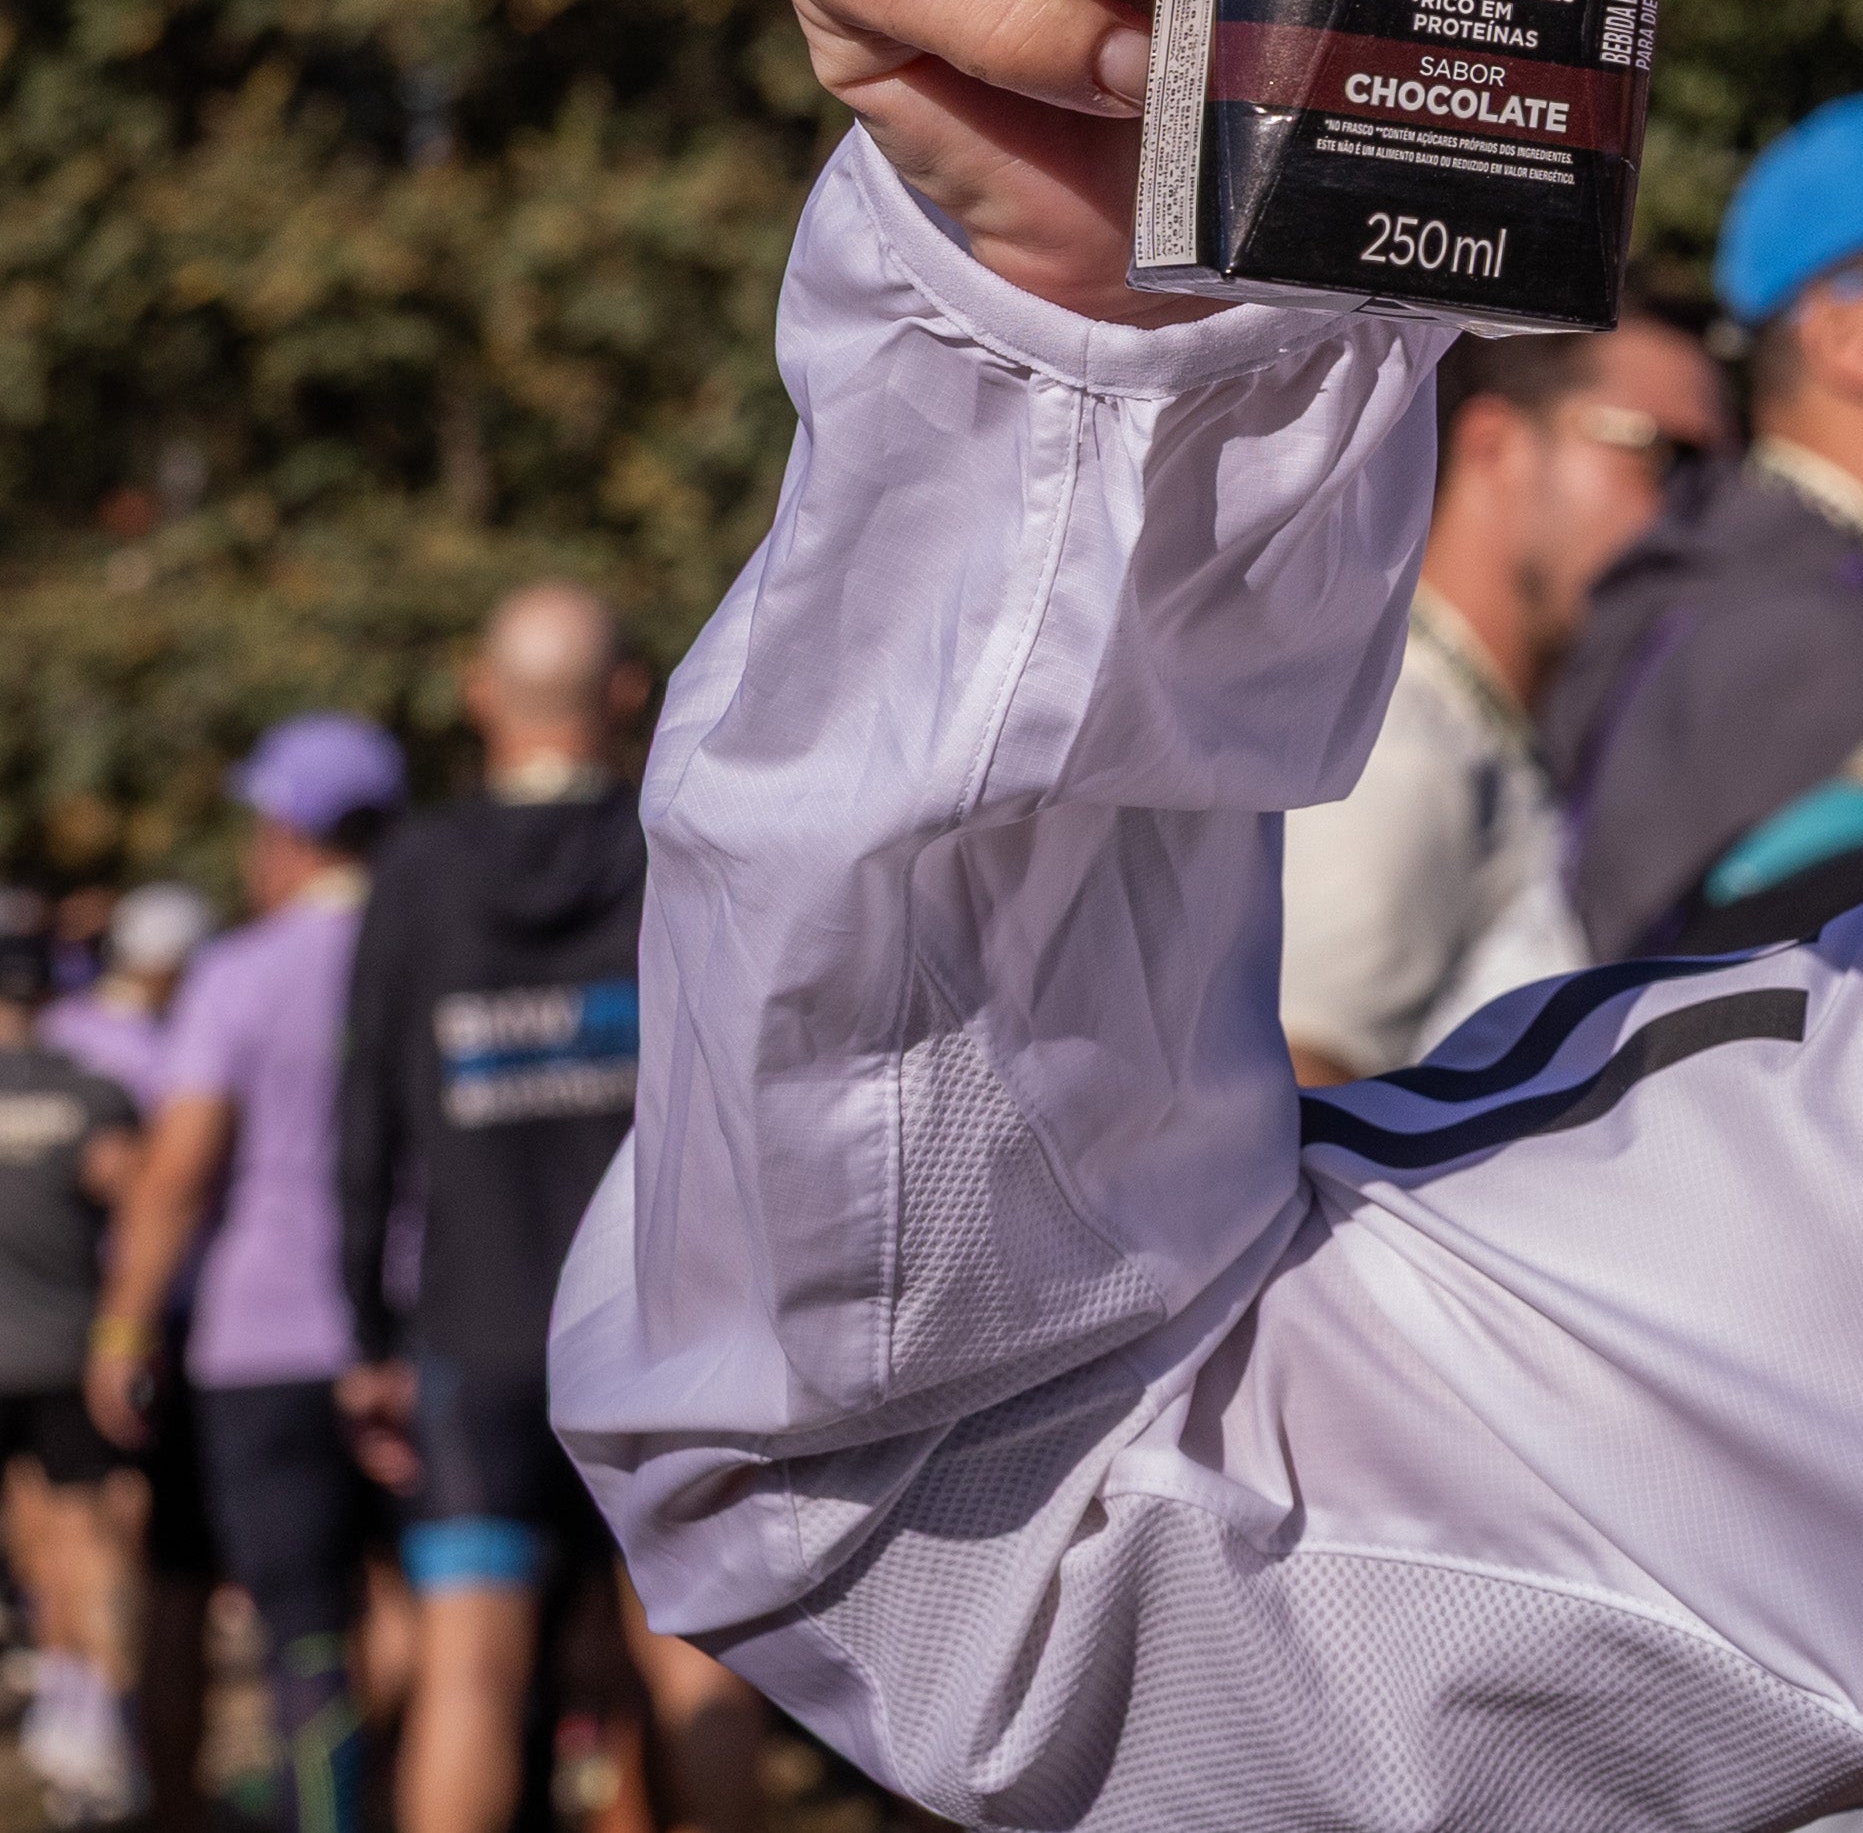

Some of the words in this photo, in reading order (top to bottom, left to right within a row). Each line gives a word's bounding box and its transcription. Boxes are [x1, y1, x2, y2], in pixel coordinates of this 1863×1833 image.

[1480, 0, 1513, 21] EM
[1413, 13, 1539, 49] PROTEÍNAS
[1600, 6, 1637, 65] BEBIDA
[1635, 29, 1654, 71] PARA
[1419, 56, 1506, 86] SABOR
[1345, 73, 1570, 133] CHOCOLATE
[1341, 121, 1374, 136] FRASCO
[1499, 144, 1516, 156] DOS
[1375, 146, 1414, 162] ALIMENTO
[1415, 152, 1439, 166] BAIXO
[1503, 164, 1528, 178] VALOR
